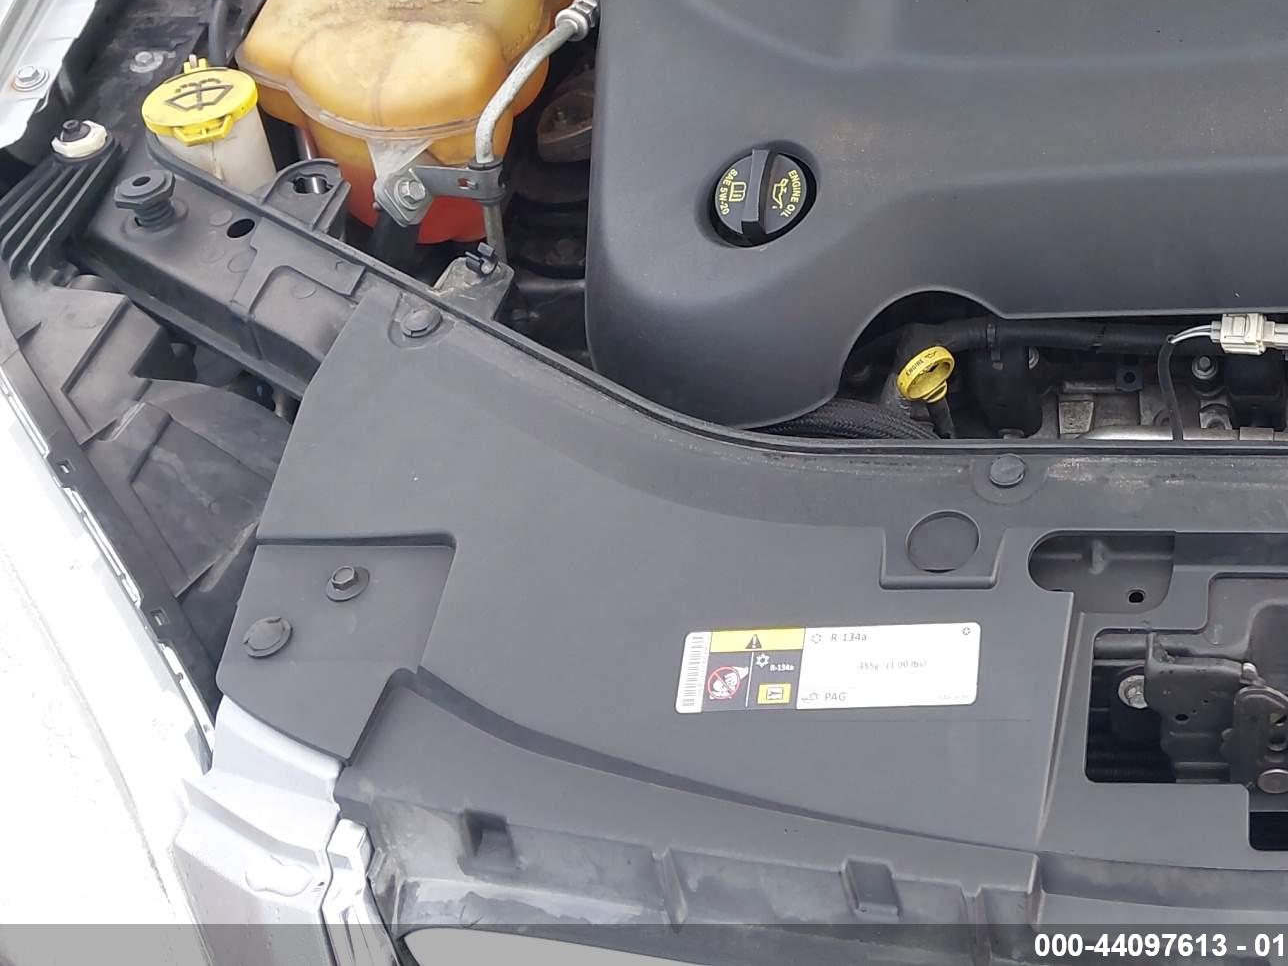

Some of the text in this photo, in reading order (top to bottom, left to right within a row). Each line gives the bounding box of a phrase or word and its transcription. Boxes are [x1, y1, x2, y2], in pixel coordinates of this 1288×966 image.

[722, 168, 738, 186] SAE
[780, 170, 801, 217] ENGINE OIL
[824, 692, 847, 702] PAG
